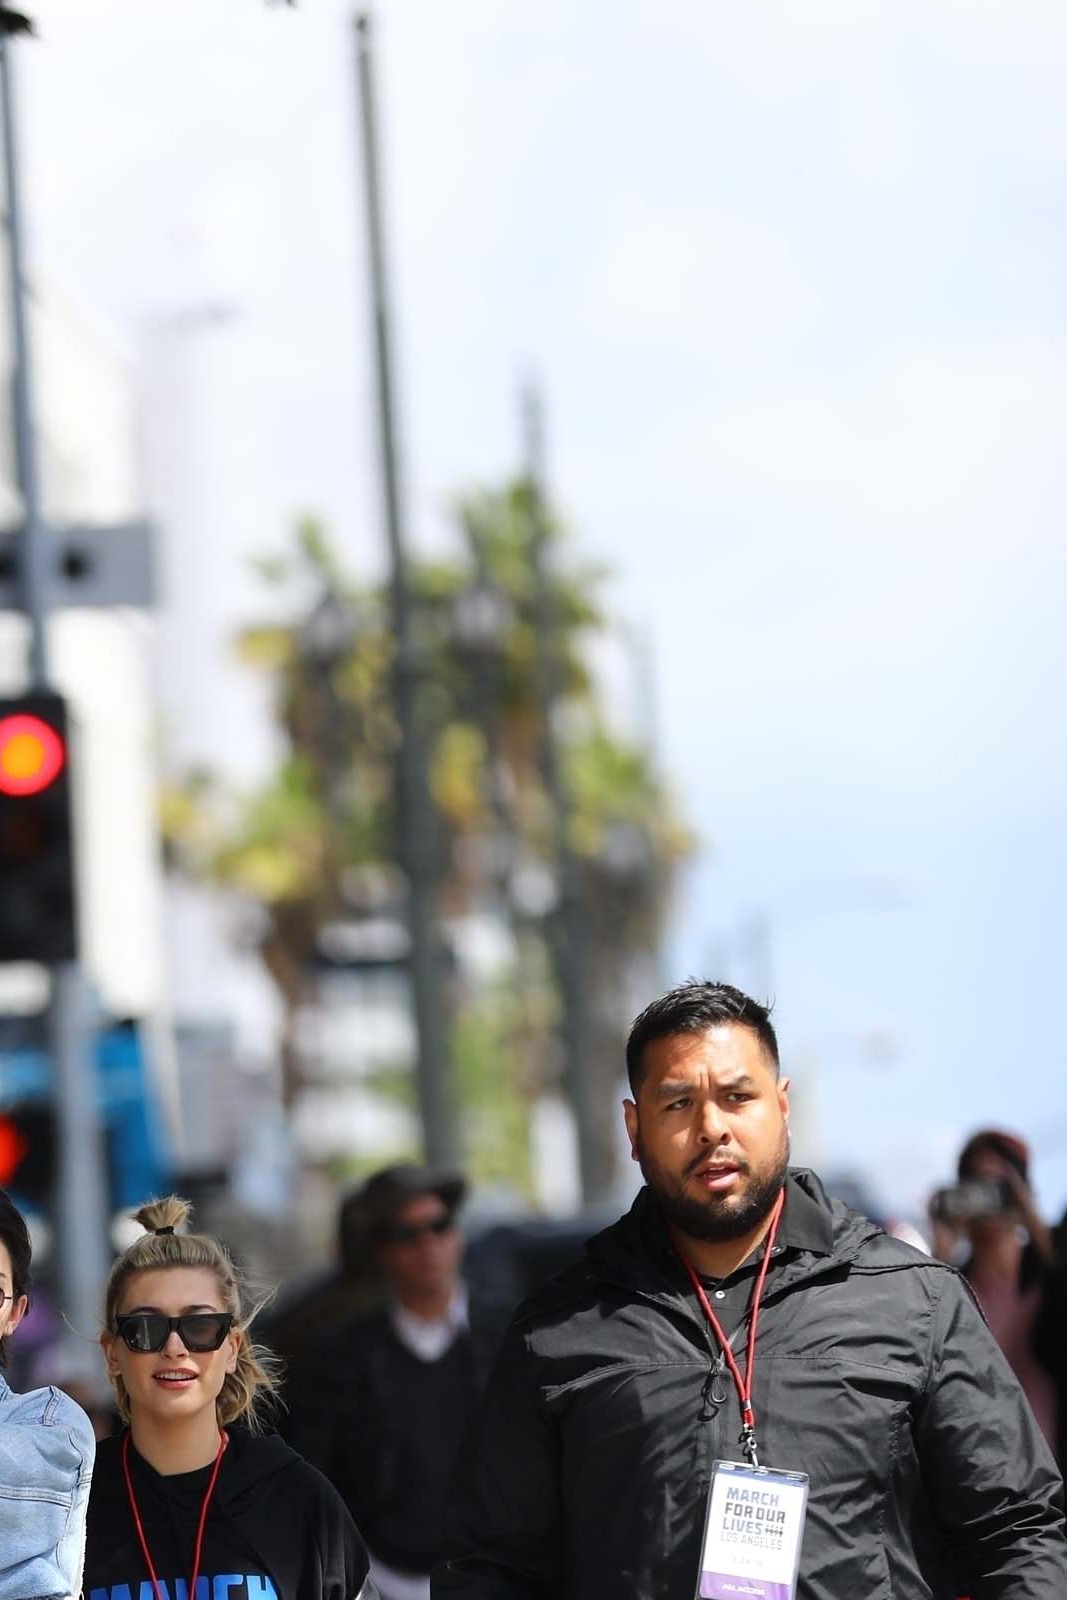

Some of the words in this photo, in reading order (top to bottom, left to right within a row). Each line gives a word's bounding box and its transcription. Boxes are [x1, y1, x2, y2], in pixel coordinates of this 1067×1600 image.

[726, 1487, 779, 1506] MARCH
[725, 1502, 752, 1519] FOR
[756, 1507, 786, 1524] OUR
[722, 1518, 763, 1535] LIVES
[720, 1532, 738, 1543] LOS
[740, 1533, 782, 1550] ANGELES
